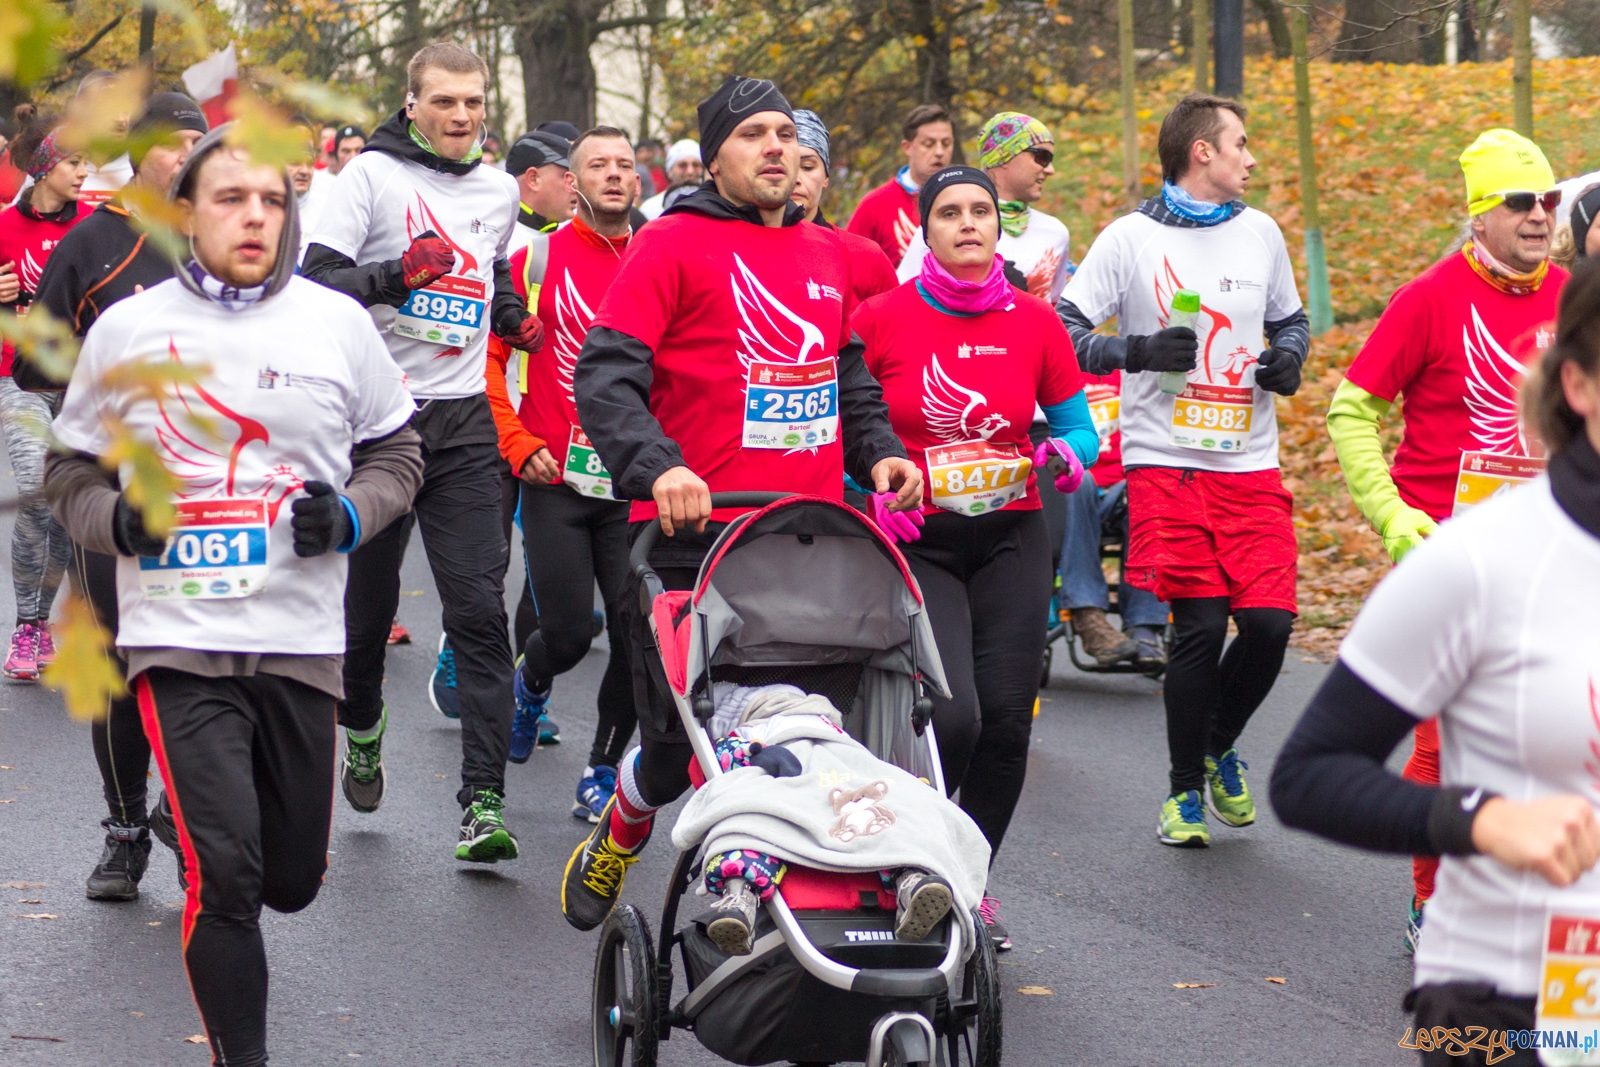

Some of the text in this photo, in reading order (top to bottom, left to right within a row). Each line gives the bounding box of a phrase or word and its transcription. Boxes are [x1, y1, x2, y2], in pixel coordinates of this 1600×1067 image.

[411, 294, 478, 325] 8954
[435, 323, 451, 331] Artur
[749, 388, 830, 420] E 2565
[1175, 404, 1247, 430] D 9982
[569, 454, 577, 463] C
[935, 461, 1021, 494] D 8477
[1460, 483, 1469, 493] D
[973, 492, 997, 501] Monika
[158, 531, 250, 567] 7061
